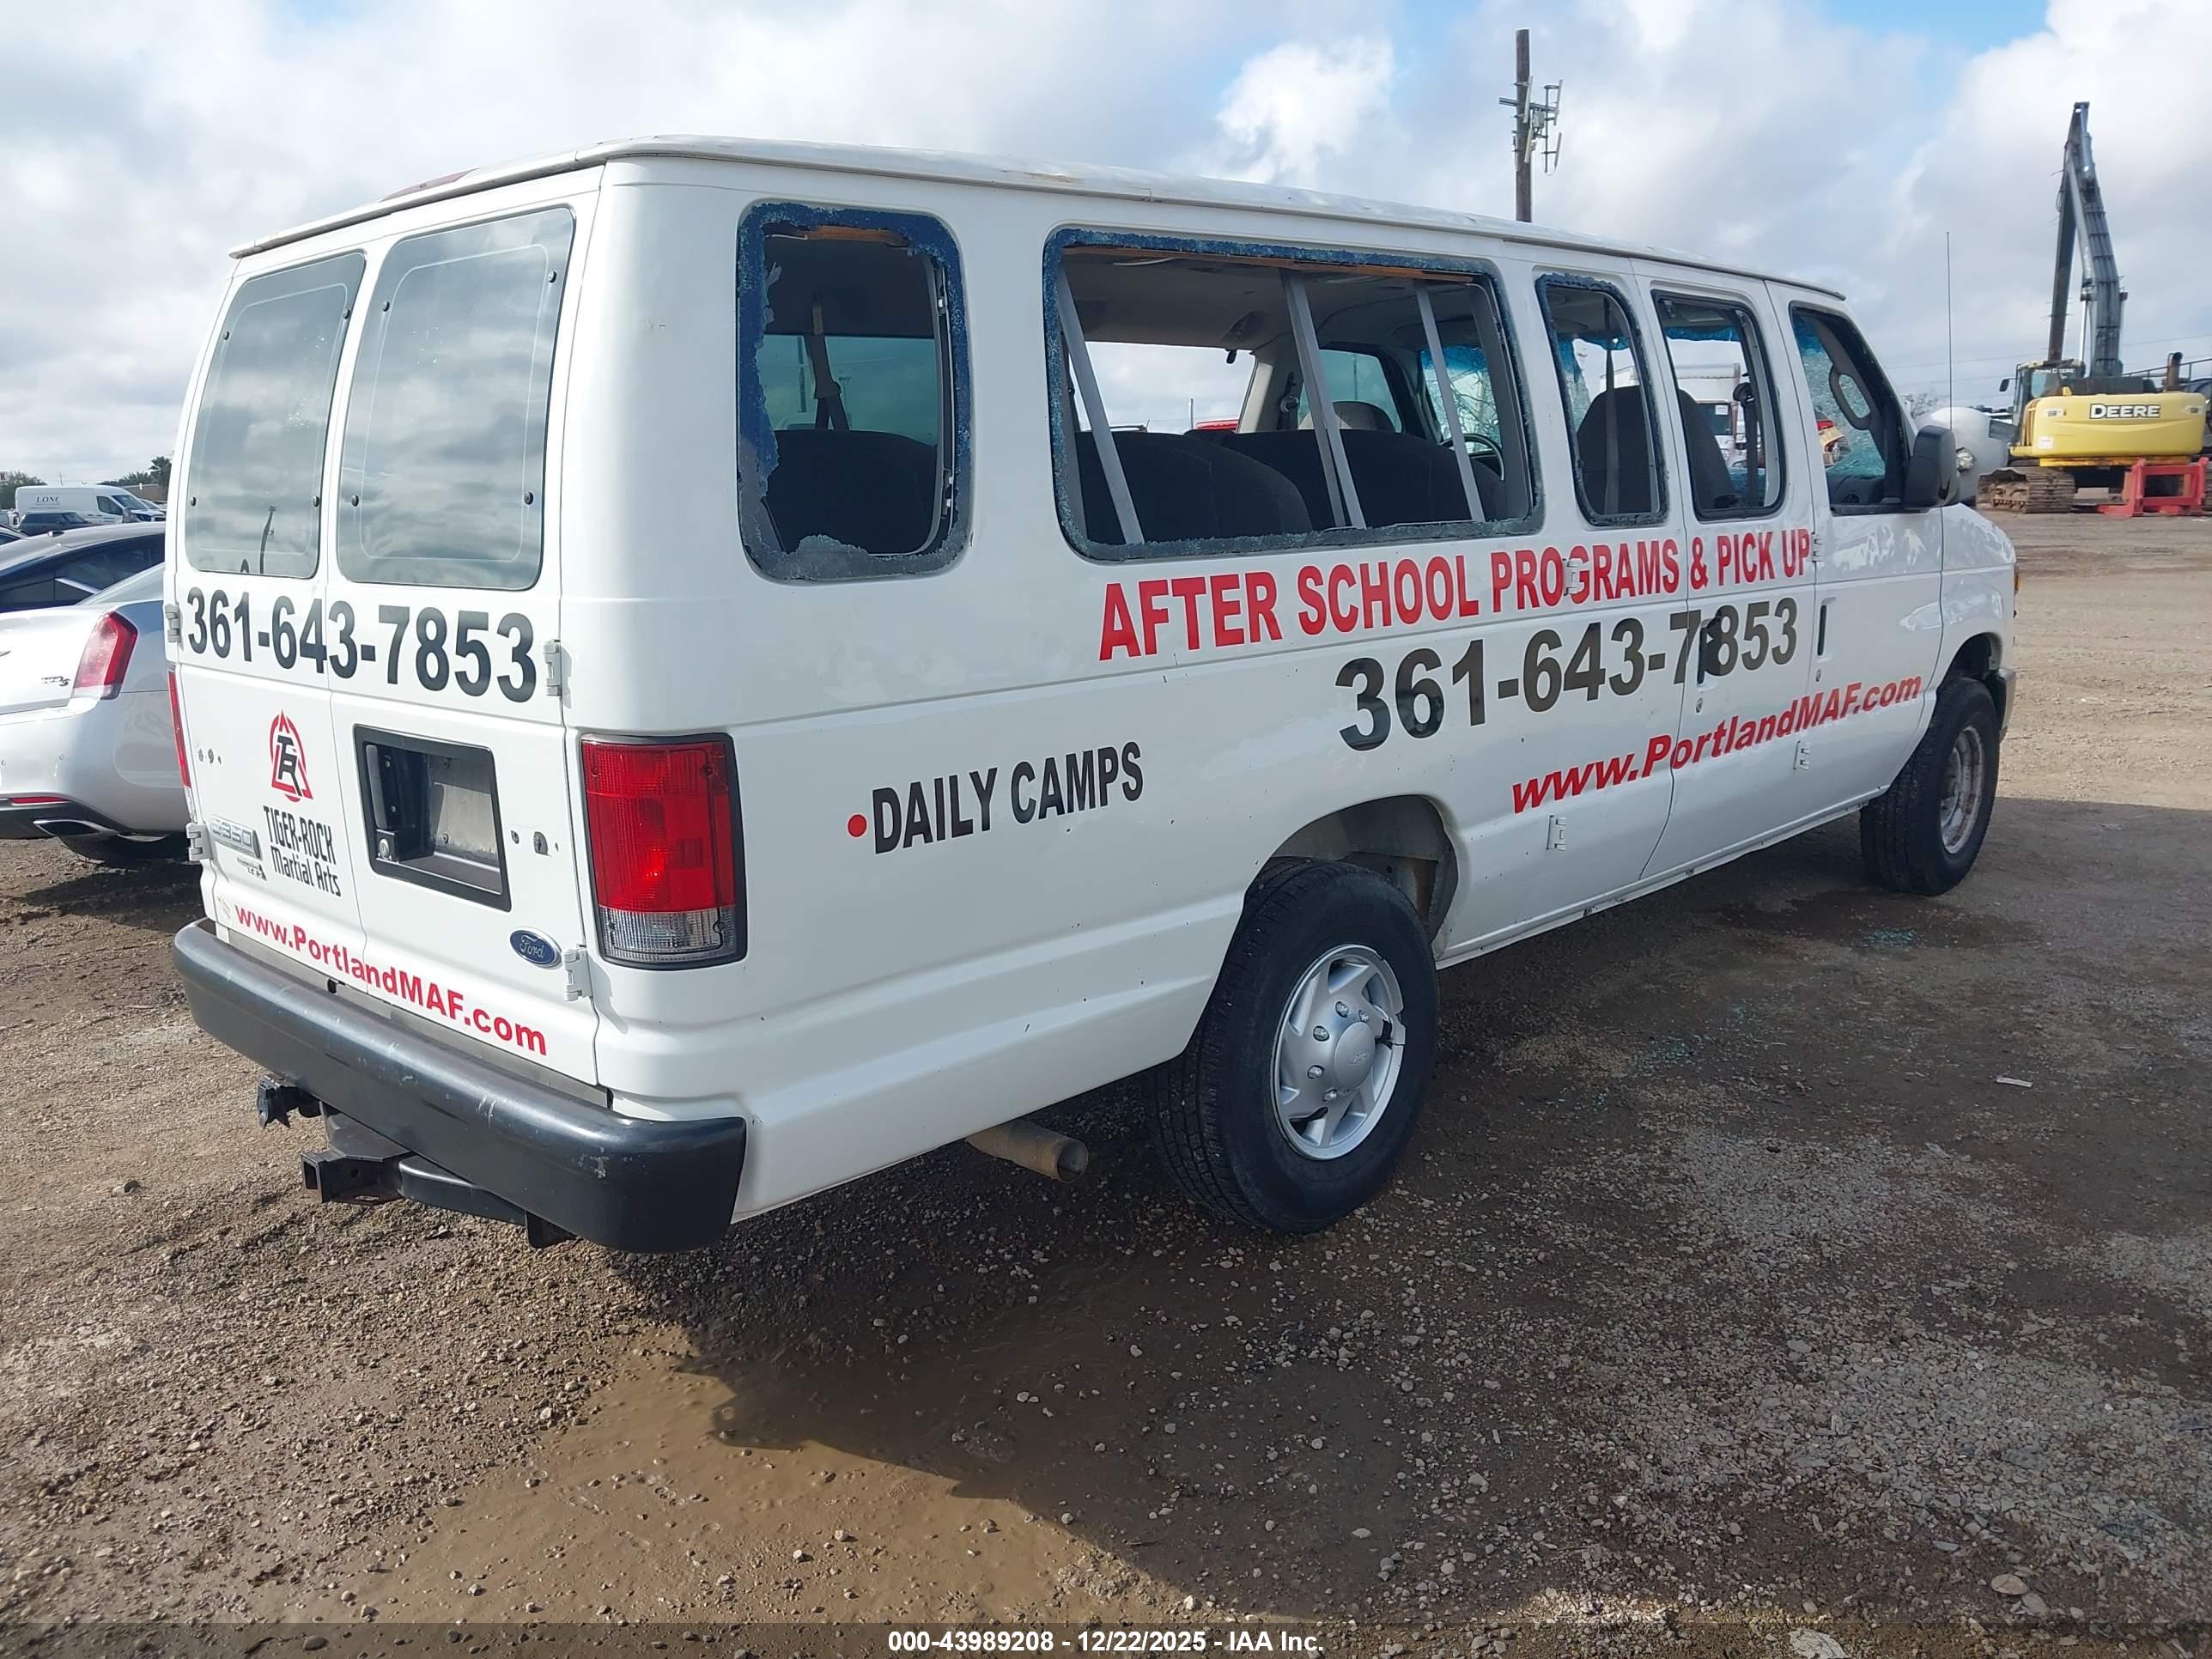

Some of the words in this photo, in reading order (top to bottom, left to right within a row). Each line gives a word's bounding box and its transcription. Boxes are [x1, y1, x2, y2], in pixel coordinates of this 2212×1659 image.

[2089, 403, 2160, 419] DEERE
[186, 586, 538, 702] 361-643-7853
[1099, 571, 1283, 661] AFTER
[1297, 556, 1480, 635] SCHOOL
[1490, 538, 1680, 613] PROGRAMS
[1689, 536, 1709, 590] &
[1717, 531, 1776, 586] PICK
[1782, 528, 1811, 577] UP
[1334, 597, 1798, 752] 361-643-7853
[872, 767, 998, 854] DAILY
[1011, 741, 1144, 824] CAMPS
[1512, 674, 1922, 814] www.PortlandMAF.com
[263, 805, 337, 866] TIGER-ROCK
[270, 845, 315, 887] Martial
[314, 861, 342, 897] Arts
[234, 903, 548, 1056] www.PortlandMAF.com
[520, 934, 545, 958] Ford
